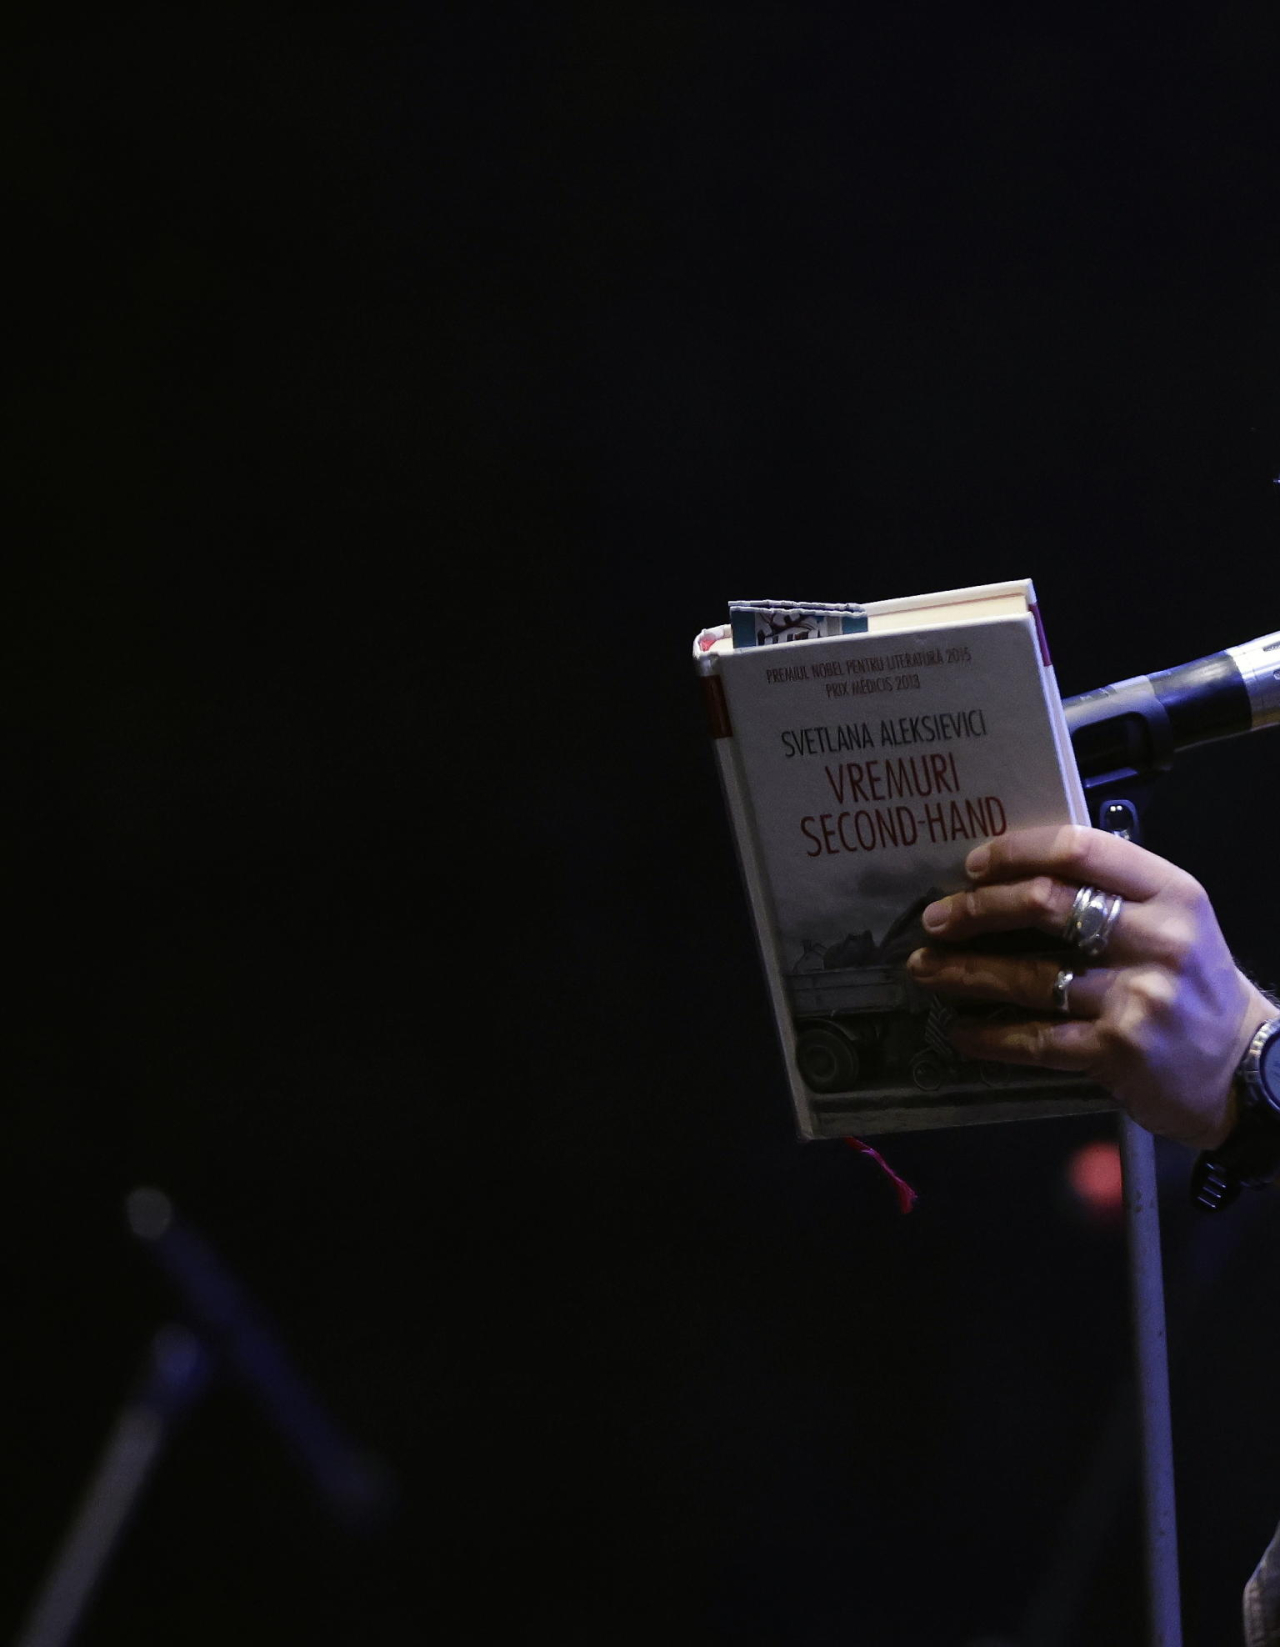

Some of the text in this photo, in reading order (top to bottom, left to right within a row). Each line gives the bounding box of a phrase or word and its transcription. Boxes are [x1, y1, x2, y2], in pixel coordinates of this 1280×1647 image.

[766, 666, 809, 684] PREMIUL
[812, 661, 845, 679] NOBEL
[846, 656, 884, 675] PENTRU
[946, 647, 971, 662] 2015
[825, 681, 848, 699] PRIX
[896, 674, 921, 691] 2013
[781, 709, 987, 758] SVETLANA ALEKSIEVICI
[825, 752, 960, 805] VREMURI
[800, 796, 1007, 857] SECOND-HAND
